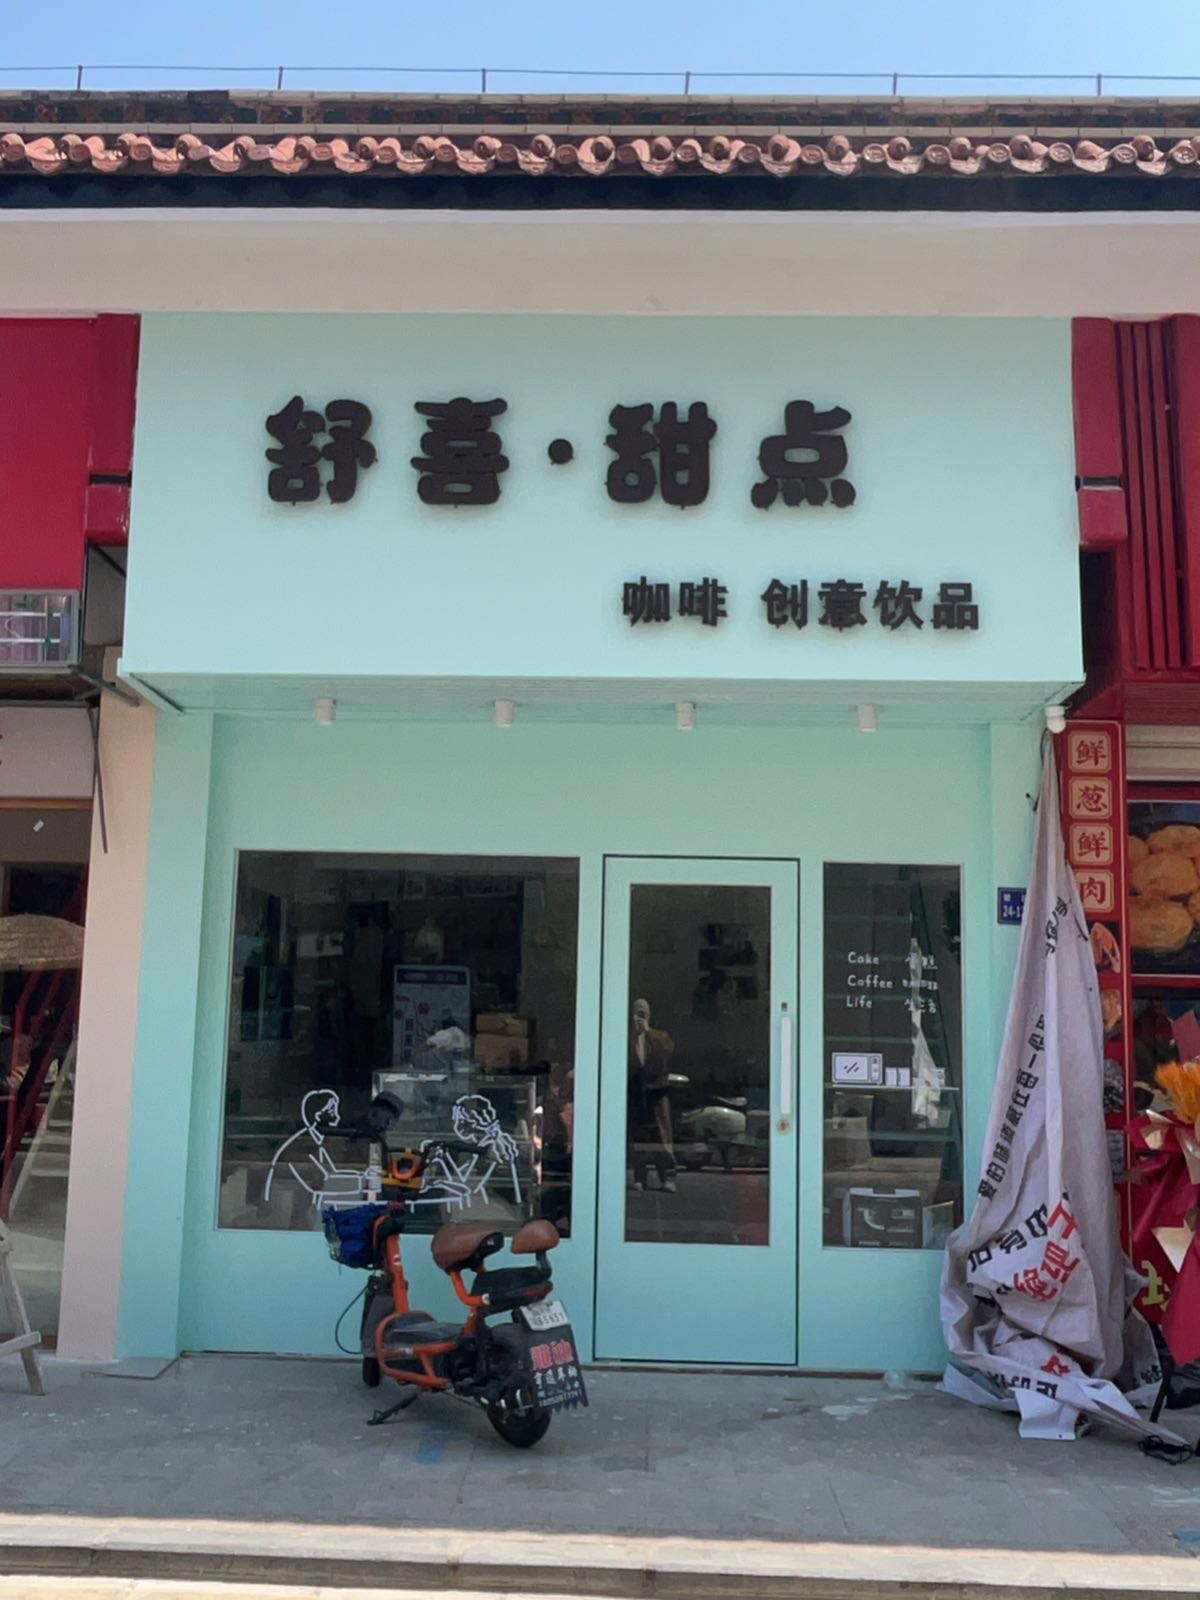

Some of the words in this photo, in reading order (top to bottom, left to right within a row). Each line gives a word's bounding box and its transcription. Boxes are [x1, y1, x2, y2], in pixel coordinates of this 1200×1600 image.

[265, 396, 856, 509] 舒喜·甜点
[623, 576, 727, 626] 咖啡
[761, 579, 978, 631] 创意饮品
[1076, 740, 1109, 904] 鲜葱鲜肉
[846, 994, 873, 1009] Life
